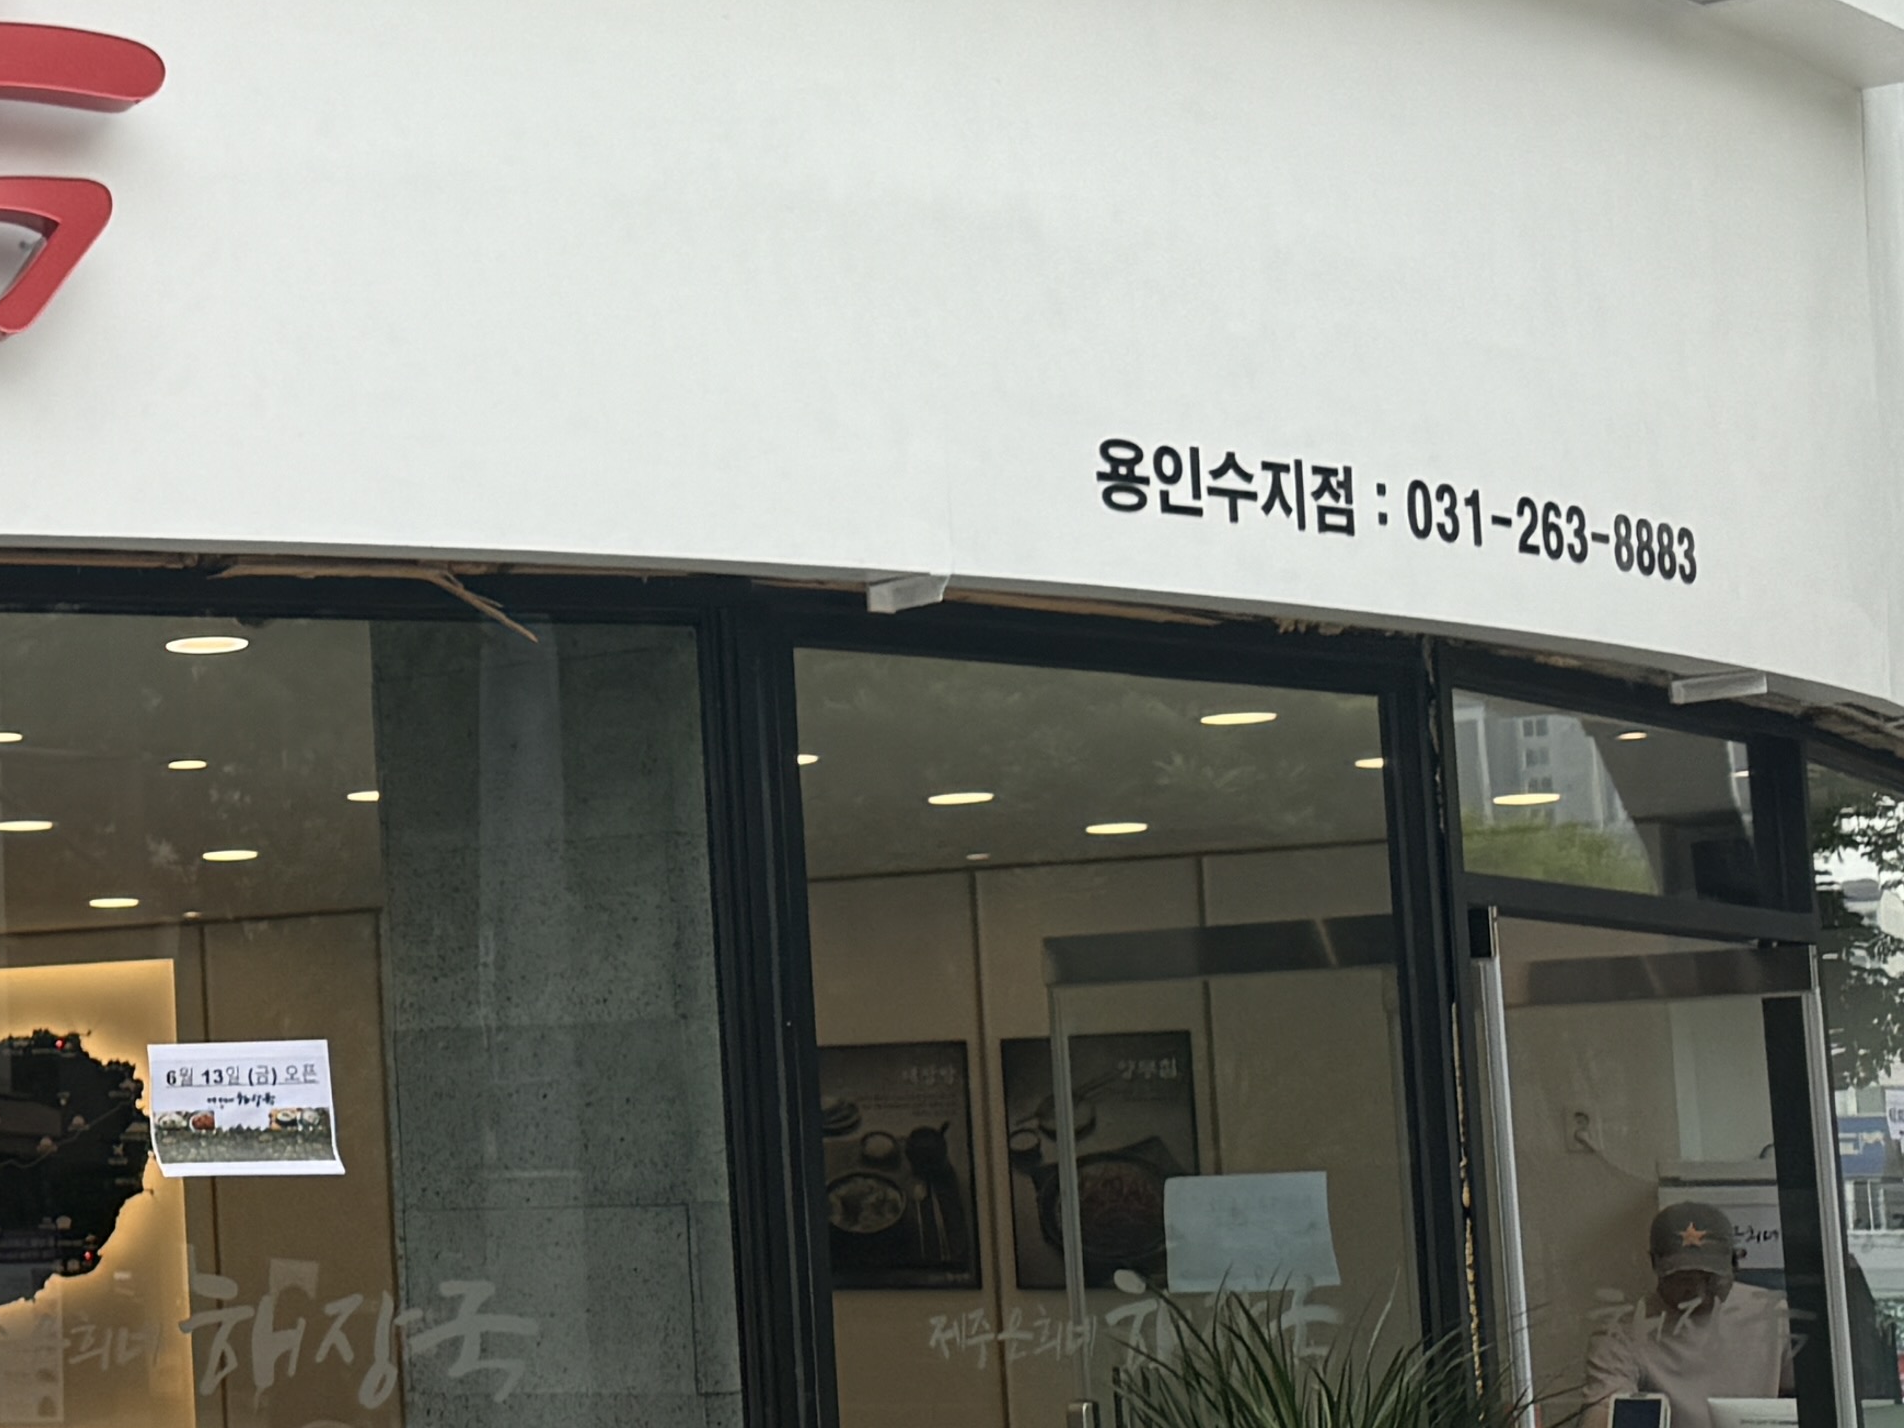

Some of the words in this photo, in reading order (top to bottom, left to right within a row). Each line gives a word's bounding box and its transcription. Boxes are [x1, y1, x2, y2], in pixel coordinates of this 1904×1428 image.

[1095, 437, 1356, 537] 용인수지점
[1406, 479, 1698, 585] 031-263-8883
[166, 1065, 194, 1088] 6월
[200, 1065, 241, 1087] 13일
[247, 1065, 279, 1088] (금)
[285, 1063, 318, 1085] 오픈
[180, 1270, 540, 1410] 해장국
